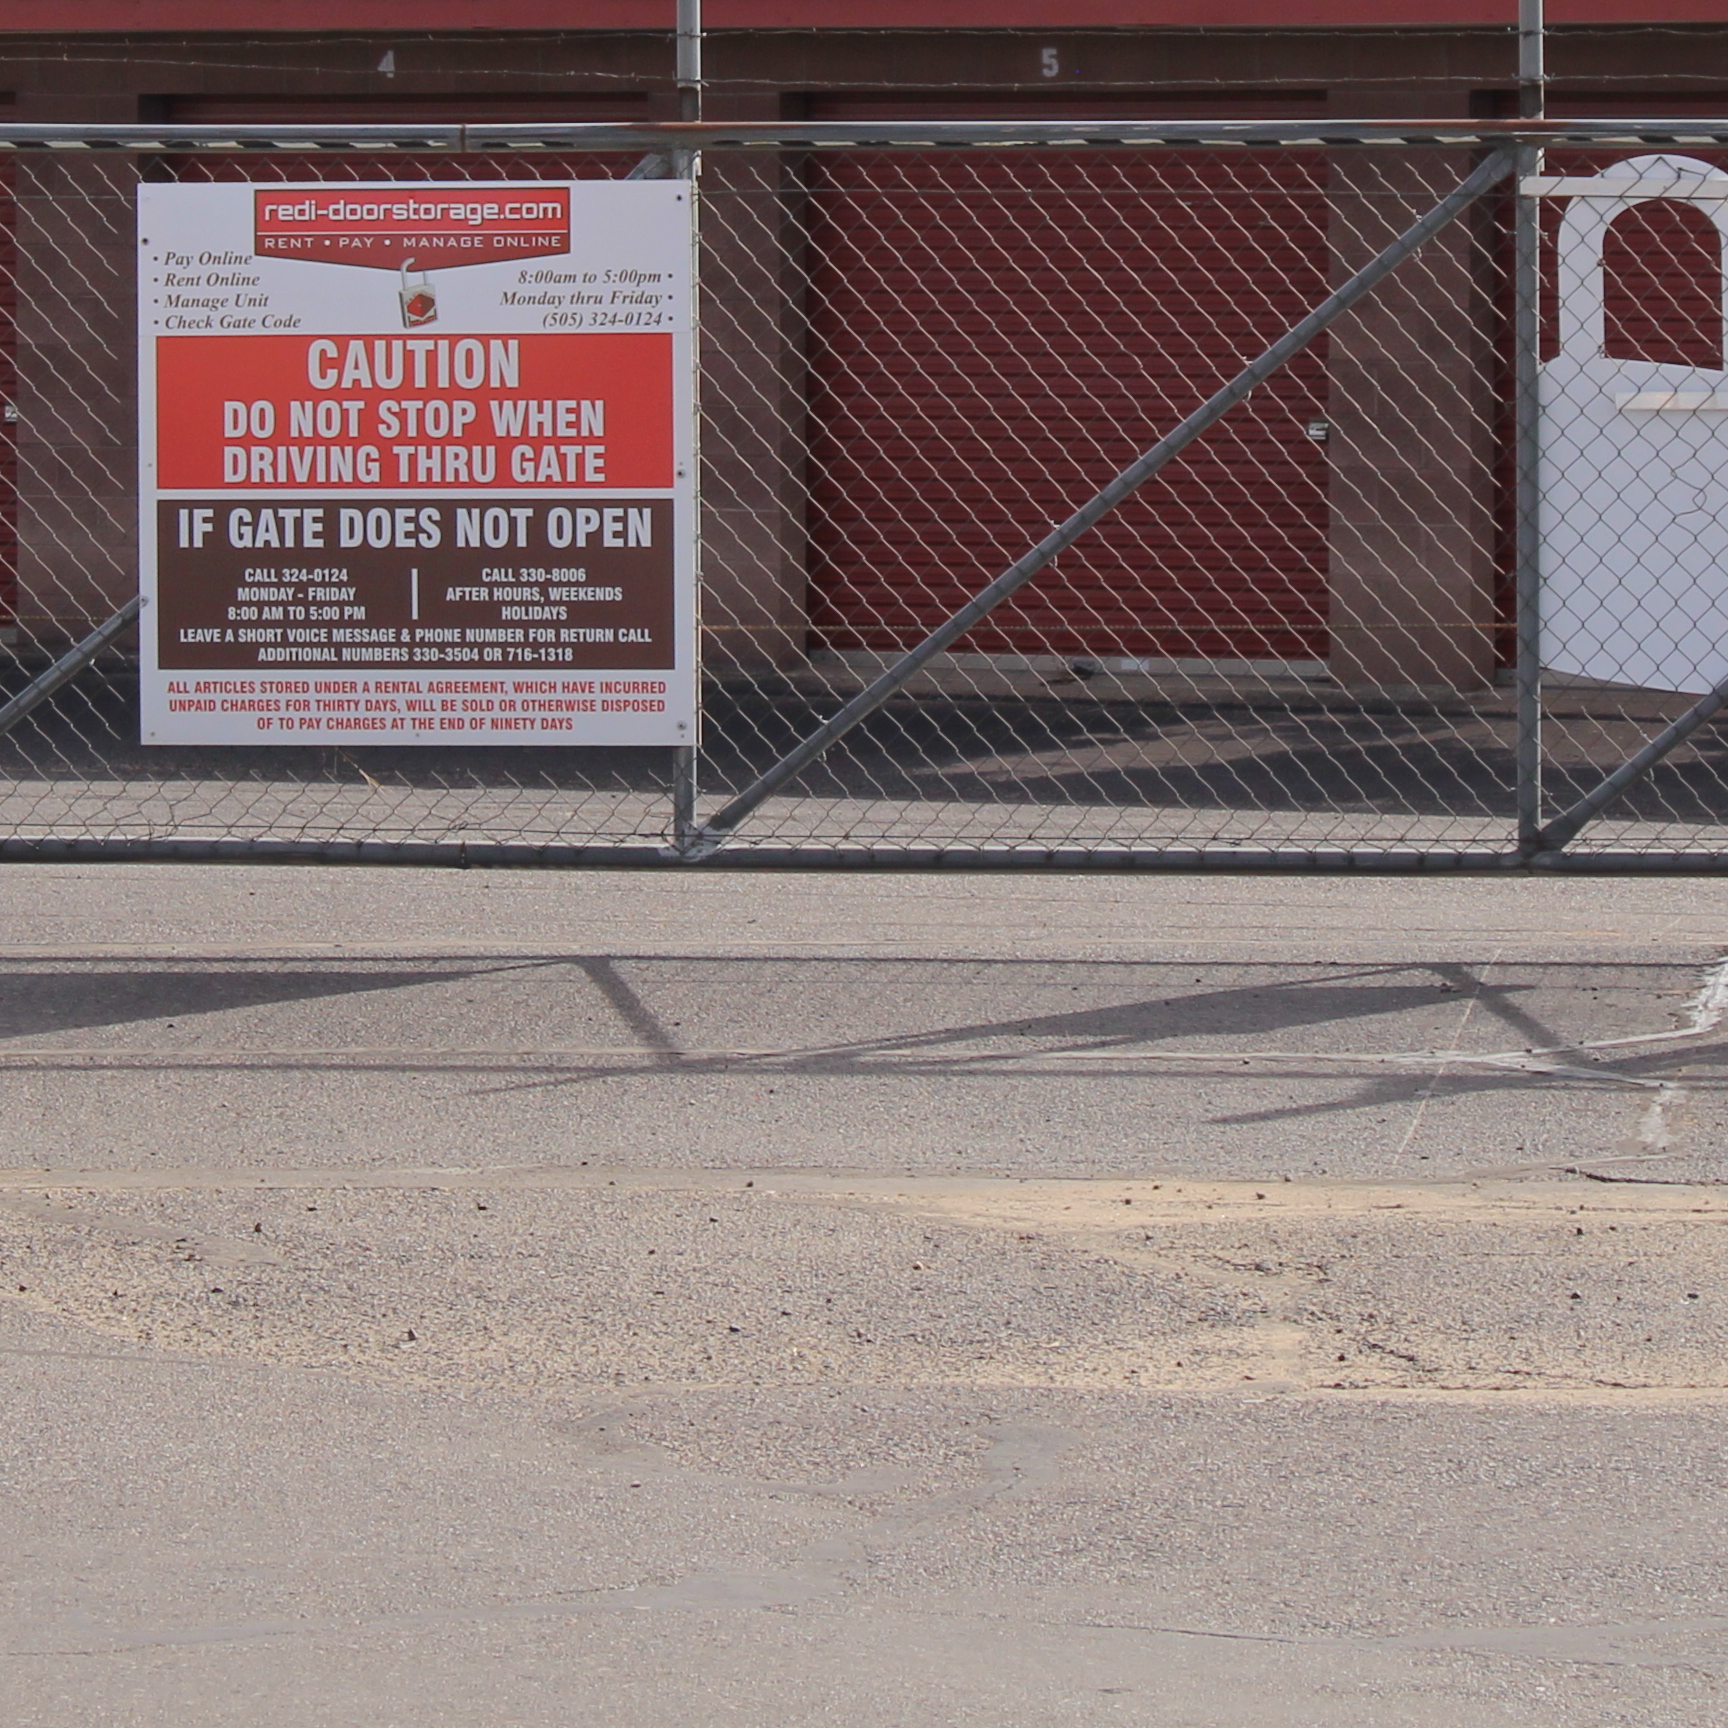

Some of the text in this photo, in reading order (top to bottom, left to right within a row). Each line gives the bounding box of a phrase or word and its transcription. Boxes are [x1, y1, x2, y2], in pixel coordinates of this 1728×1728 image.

[377, 50, 395, 77] 4
[1041, 48, 1058, 77] 5
[265, 199, 561, 225] redi-doorstorage.com
[265, 236, 560, 248] RENT PAY MANAGE ONLINE
[164, 251, 252, 269] Pay Online
[164, 273, 260, 287] Rent Online
[518, 270, 661, 287] 8:00am to 5:00pm
[164, 294, 268, 311] Manage Unit
[500, 290, 662, 309] Monday thru Friday
[165, 314, 301, 329] Check Gate Code
[543, 312, 662, 329] (505) 324-0124
[307, 339, 519, 389] CAUTION
[223, 399, 604, 439] DO NOT STOP WHEN
[223, 444, 606, 483] DRIVING THRU GATE
[178, 508, 652, 549] IF GATE DOES NOT OPEN
[245, 568, 348, 582] CALL 324-0124
[482, 568, 586, 582] CALL 330-8006
[237, 587, 294, 601] MONDAY
[308, 587, 356, 601] FRIDAY
[446, 587, 622, 603] AFTER HOURS, WEEKENDS
[228, 606, 365, 620] 8:00 AM TO 5:00 PM
[502, 606, 567, 620] HOLIDAYS
[180, 629, 652, 642] LEAVE A SHORT VOICE MESSAGE & PHONE NUMBER FOR RETURN CALL
[258, 648, 572, 661] ADDITIONAL NUMBERS 330-3504 OR 716-1318
[168, 681, 666, 696] ALL ARTICLES STORED UNDER A RENTAL AGREEMENT, WHICH HAVE INCURRED
[169, 699, 665, 714] UNPAID CHARGES FOR THIRTY DAYS, WILL BE SOLD OR OTHERWISE DISPOSED
[257, 718, 573, 730] OF TO PAY CHARGES AT THE END OF NINETY DAYS
